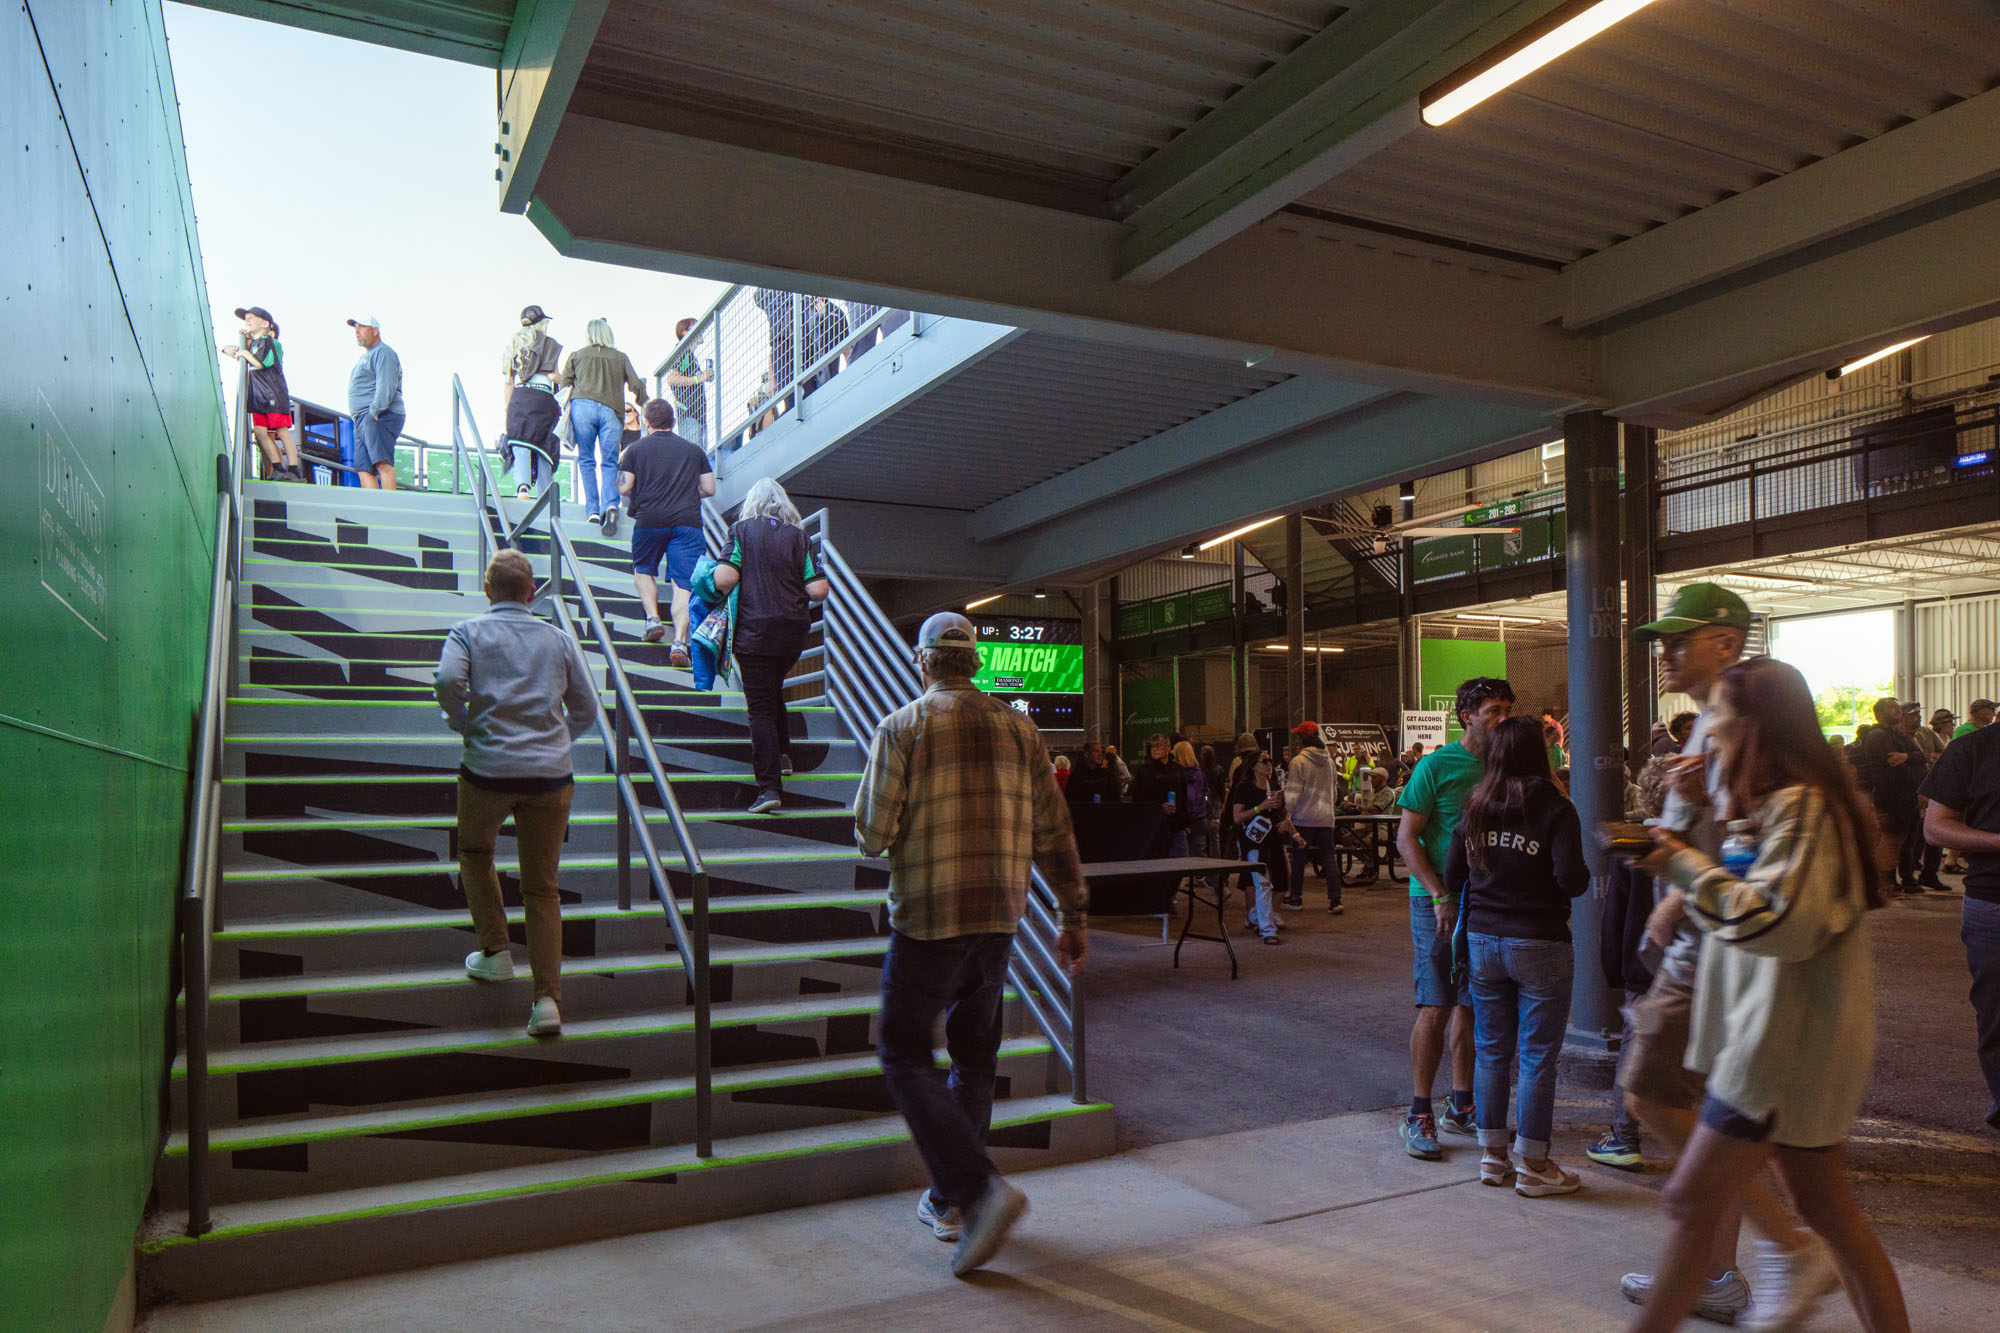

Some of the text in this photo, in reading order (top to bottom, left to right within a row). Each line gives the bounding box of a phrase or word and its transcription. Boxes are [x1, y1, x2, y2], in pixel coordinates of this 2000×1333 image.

[45, 430, 102, 556] DIAMOND
[1488, 508, 1499, 520] 201
[1504, 503, 1517, 516] 202
[982, 626, 1000, 636] UP:
[1009, 625, 1044, 641] 3:27
[989, 647, 1058, 673] MATCH
